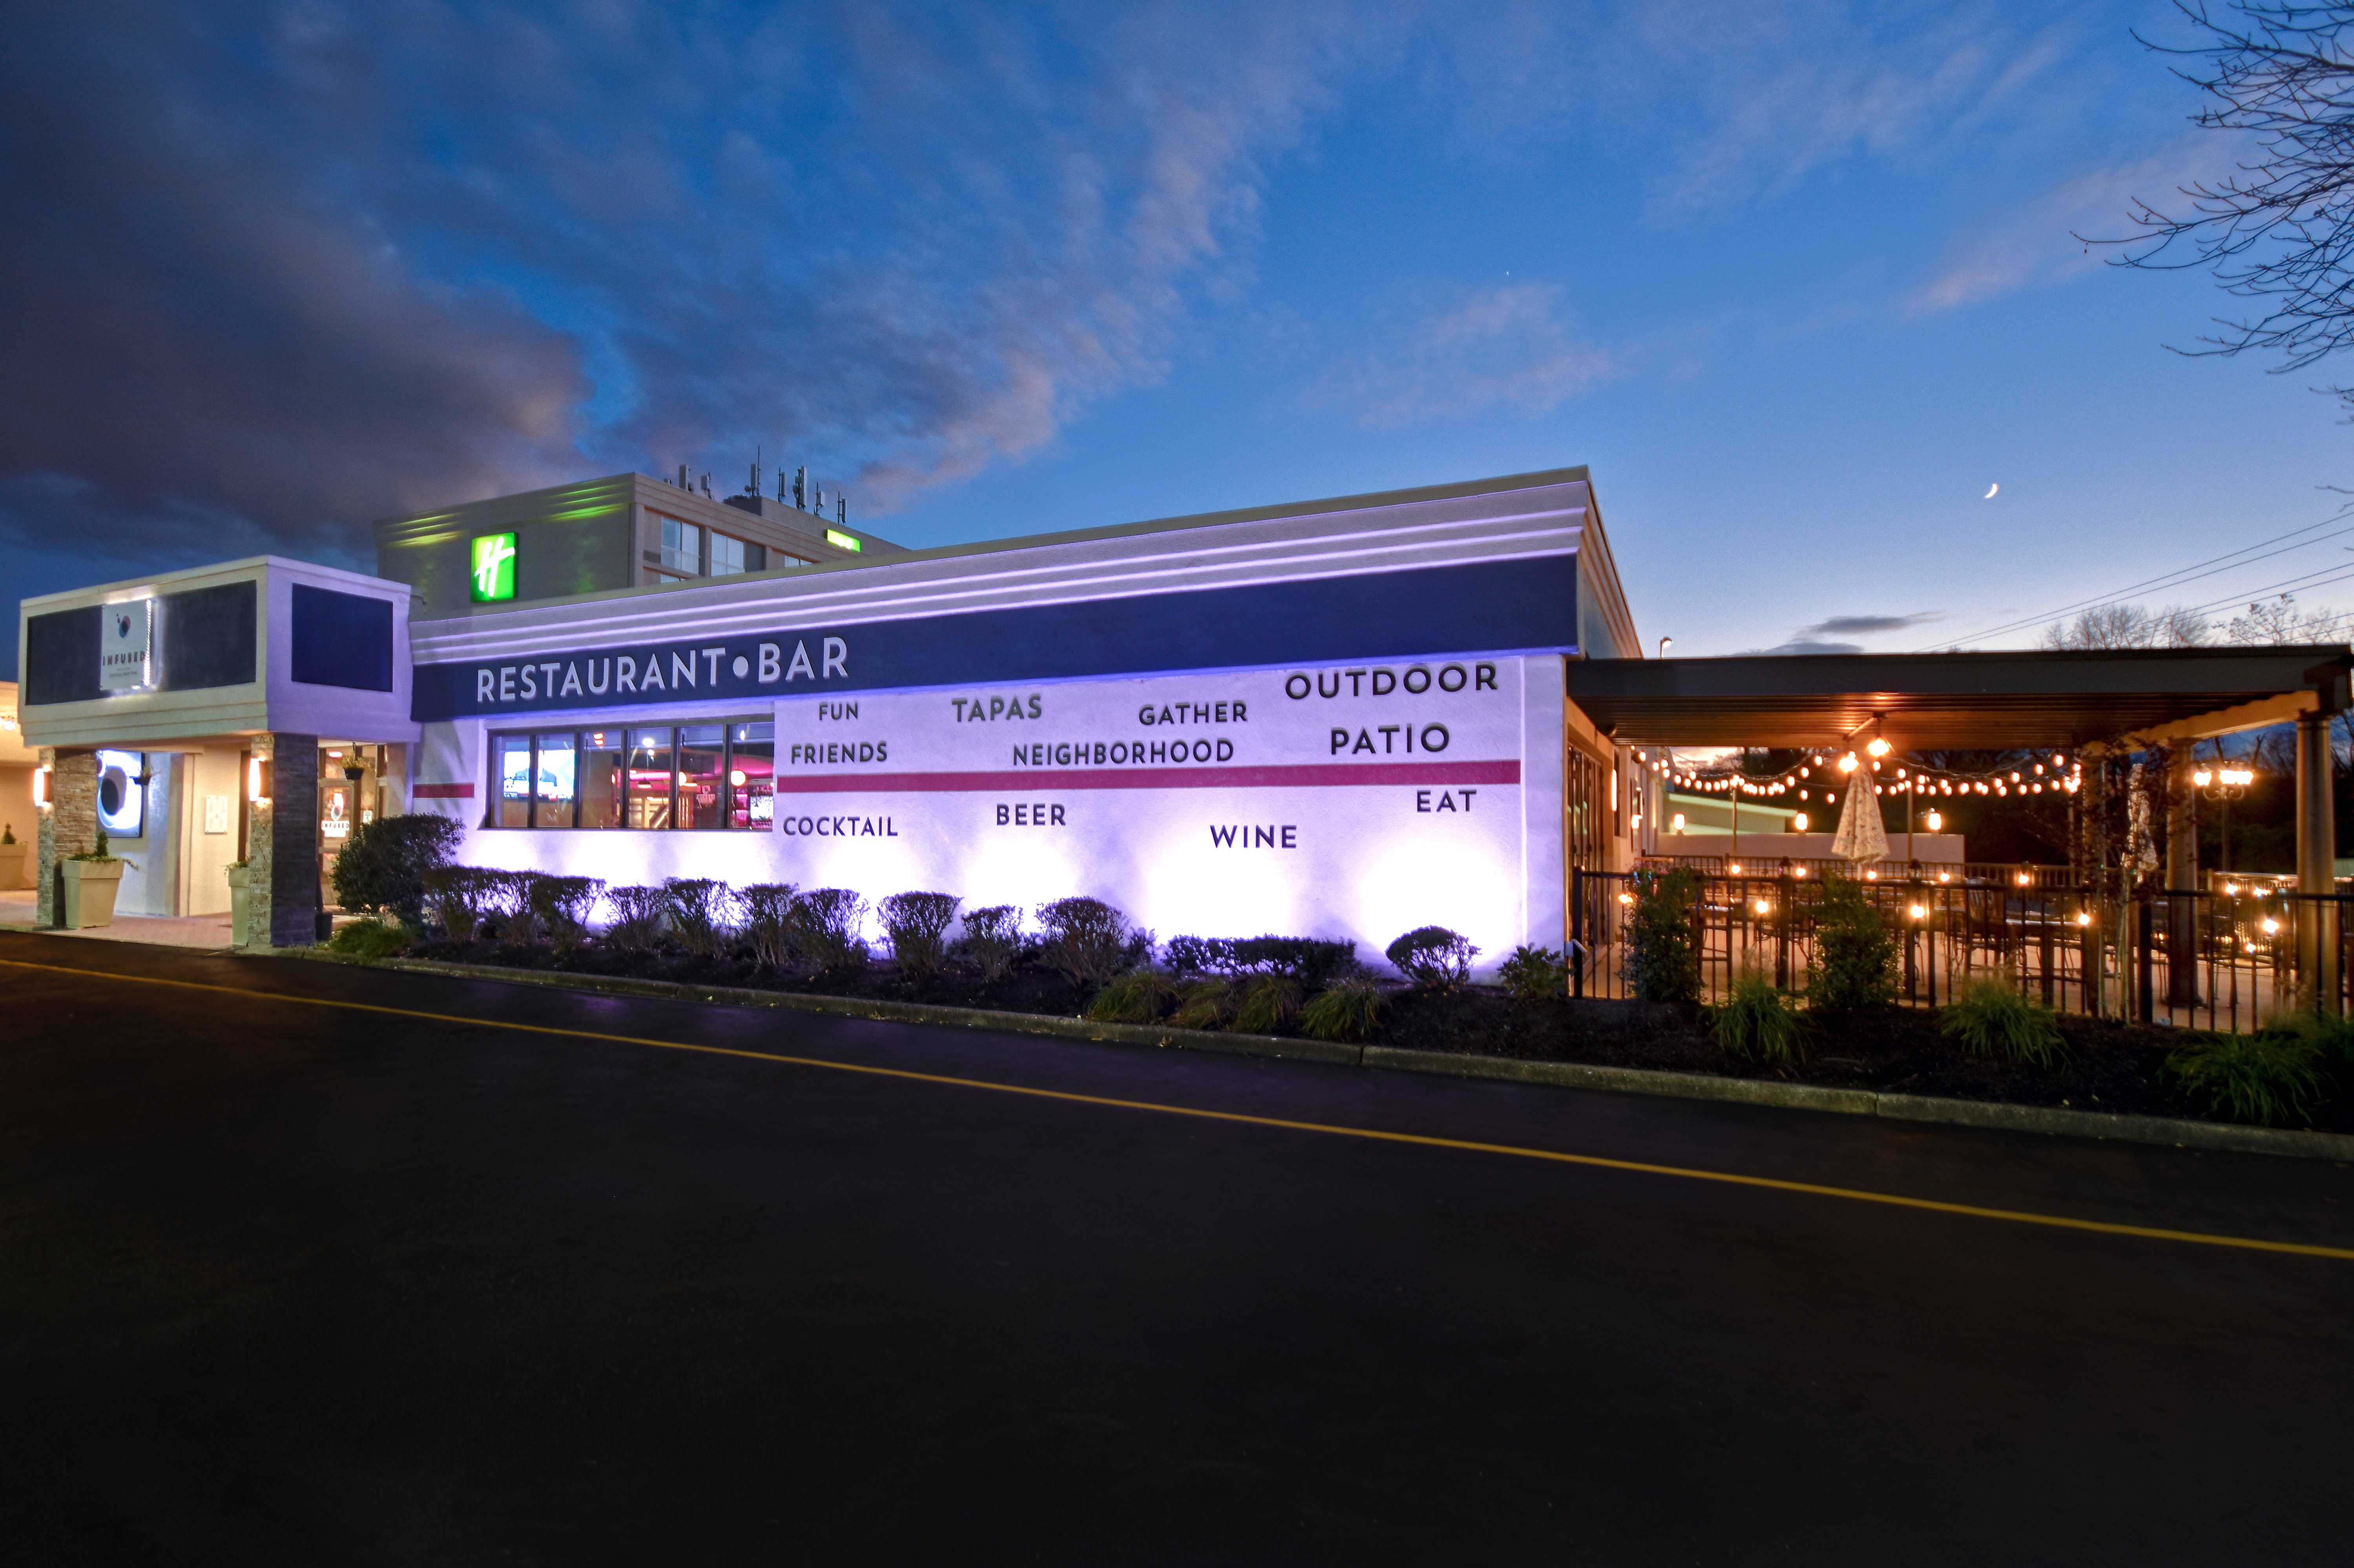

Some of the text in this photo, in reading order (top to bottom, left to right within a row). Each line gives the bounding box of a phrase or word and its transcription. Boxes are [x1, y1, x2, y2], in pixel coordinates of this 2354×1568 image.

[102, 651, 145, 666] INFUSED
[477, 636, 849, 703] RESTAURANT BAR
[1285, 663, 1499, 700] OUTDOOR
[819, 702, 858, 721] FUN
[952, 694, 1042, 723] TAPAS
[1139, 700, 1248, 726] GATHER
[1331, 722, 1450, 755] PATIO
[791, 741, 888, 765] FRIENDS
[1013, 738, 1234, 766] NEIGHBORHOOD
[1416, 789, 1477, 813] EAT
[783, 816, 898, 837] COCKTAIL
[996, 803, 1066, 826] BEER
[1210, 824, 1297, 849] WINE
